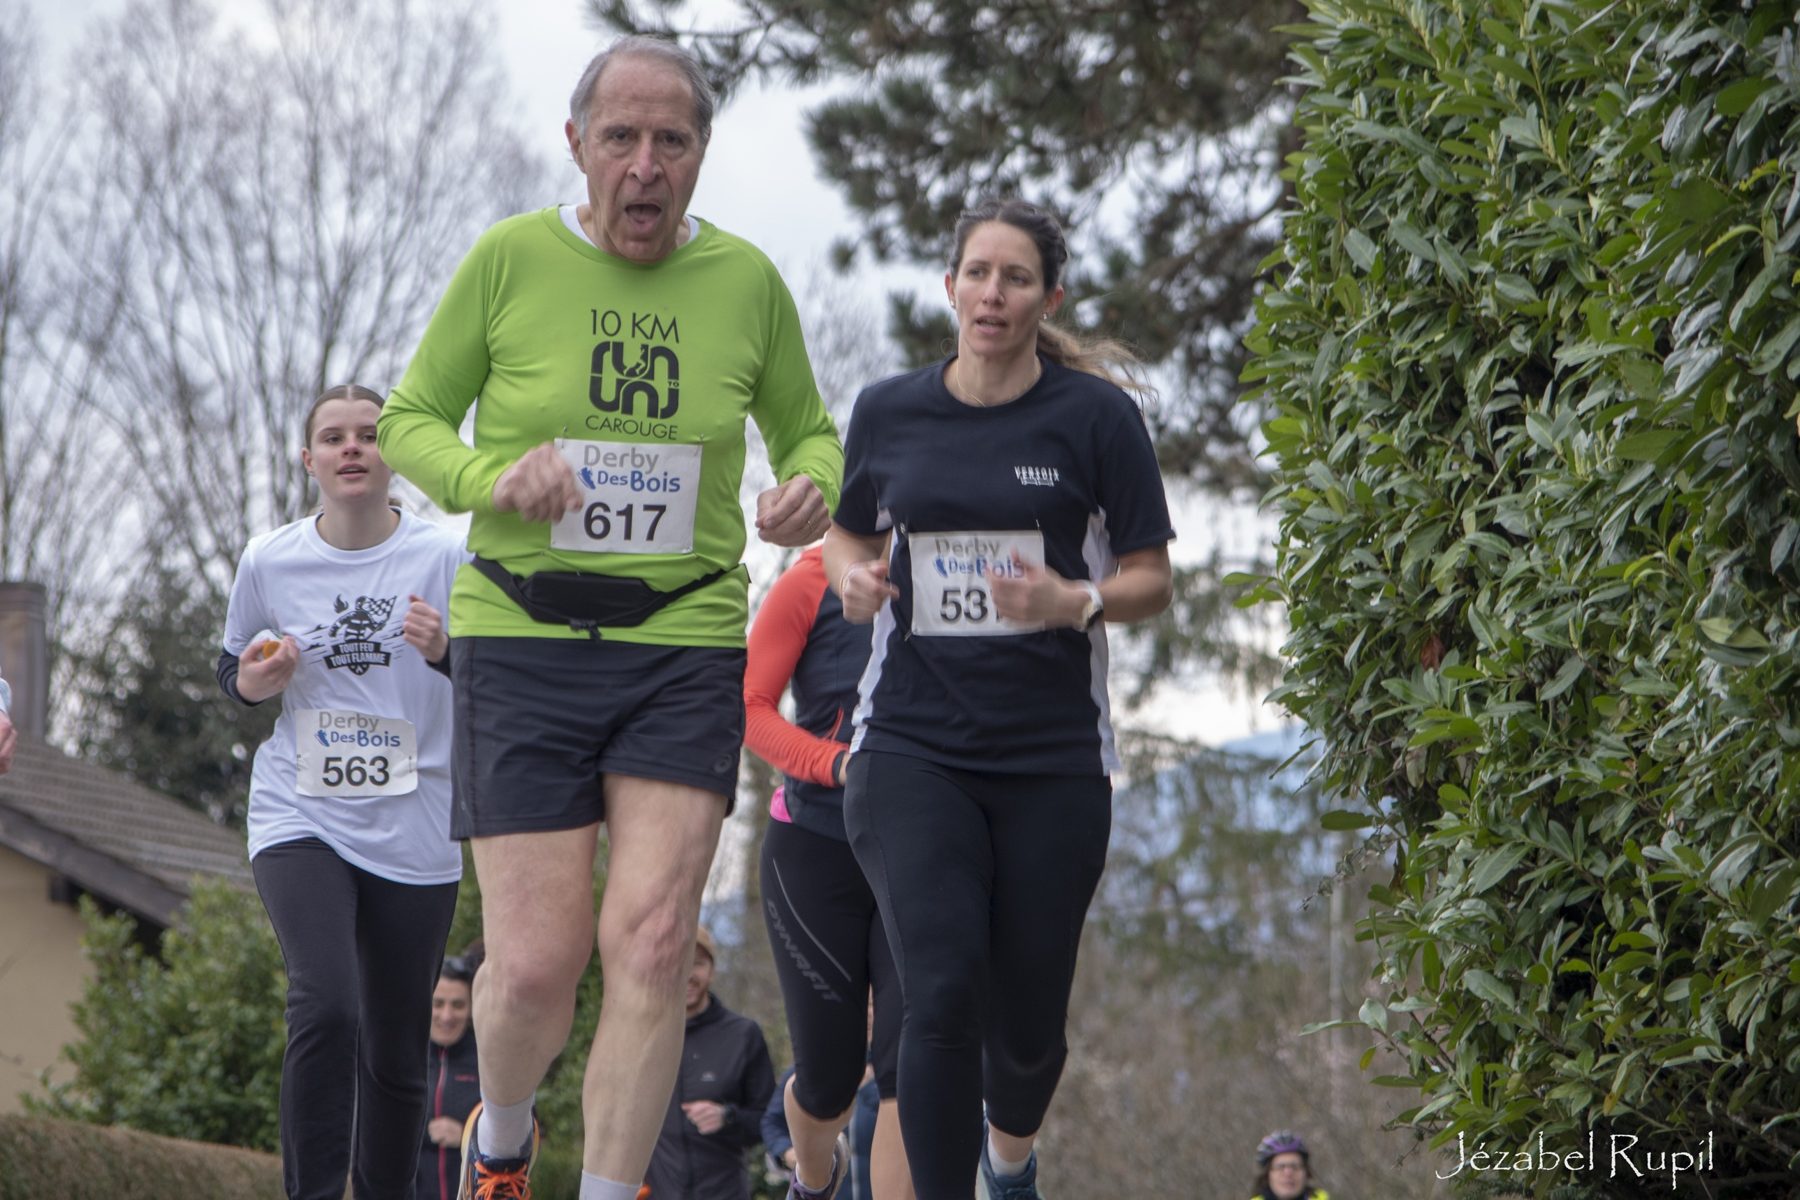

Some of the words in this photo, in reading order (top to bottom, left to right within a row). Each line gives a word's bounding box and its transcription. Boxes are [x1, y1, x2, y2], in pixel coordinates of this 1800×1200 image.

[590, 308, 622, 337] 10
[631, 311, 680, 344] KM
[585, 414, 679, 441] CAROUGE
[583, 444, 660, 475] Derby
[583, 501, 668, 543] 617
[934, 537, 1001, 557] Derby
[940, 587, 1001, 624] 53
[330, 655, 351, 666] TOUT
[351, 652, 386, 665] FLAMME
[339, 643, 358, 654] TOUT
[359, 642, 375, 652] FEU
[318, 711, 380, 733] Derby
[321, 755, 390, 788] 563
